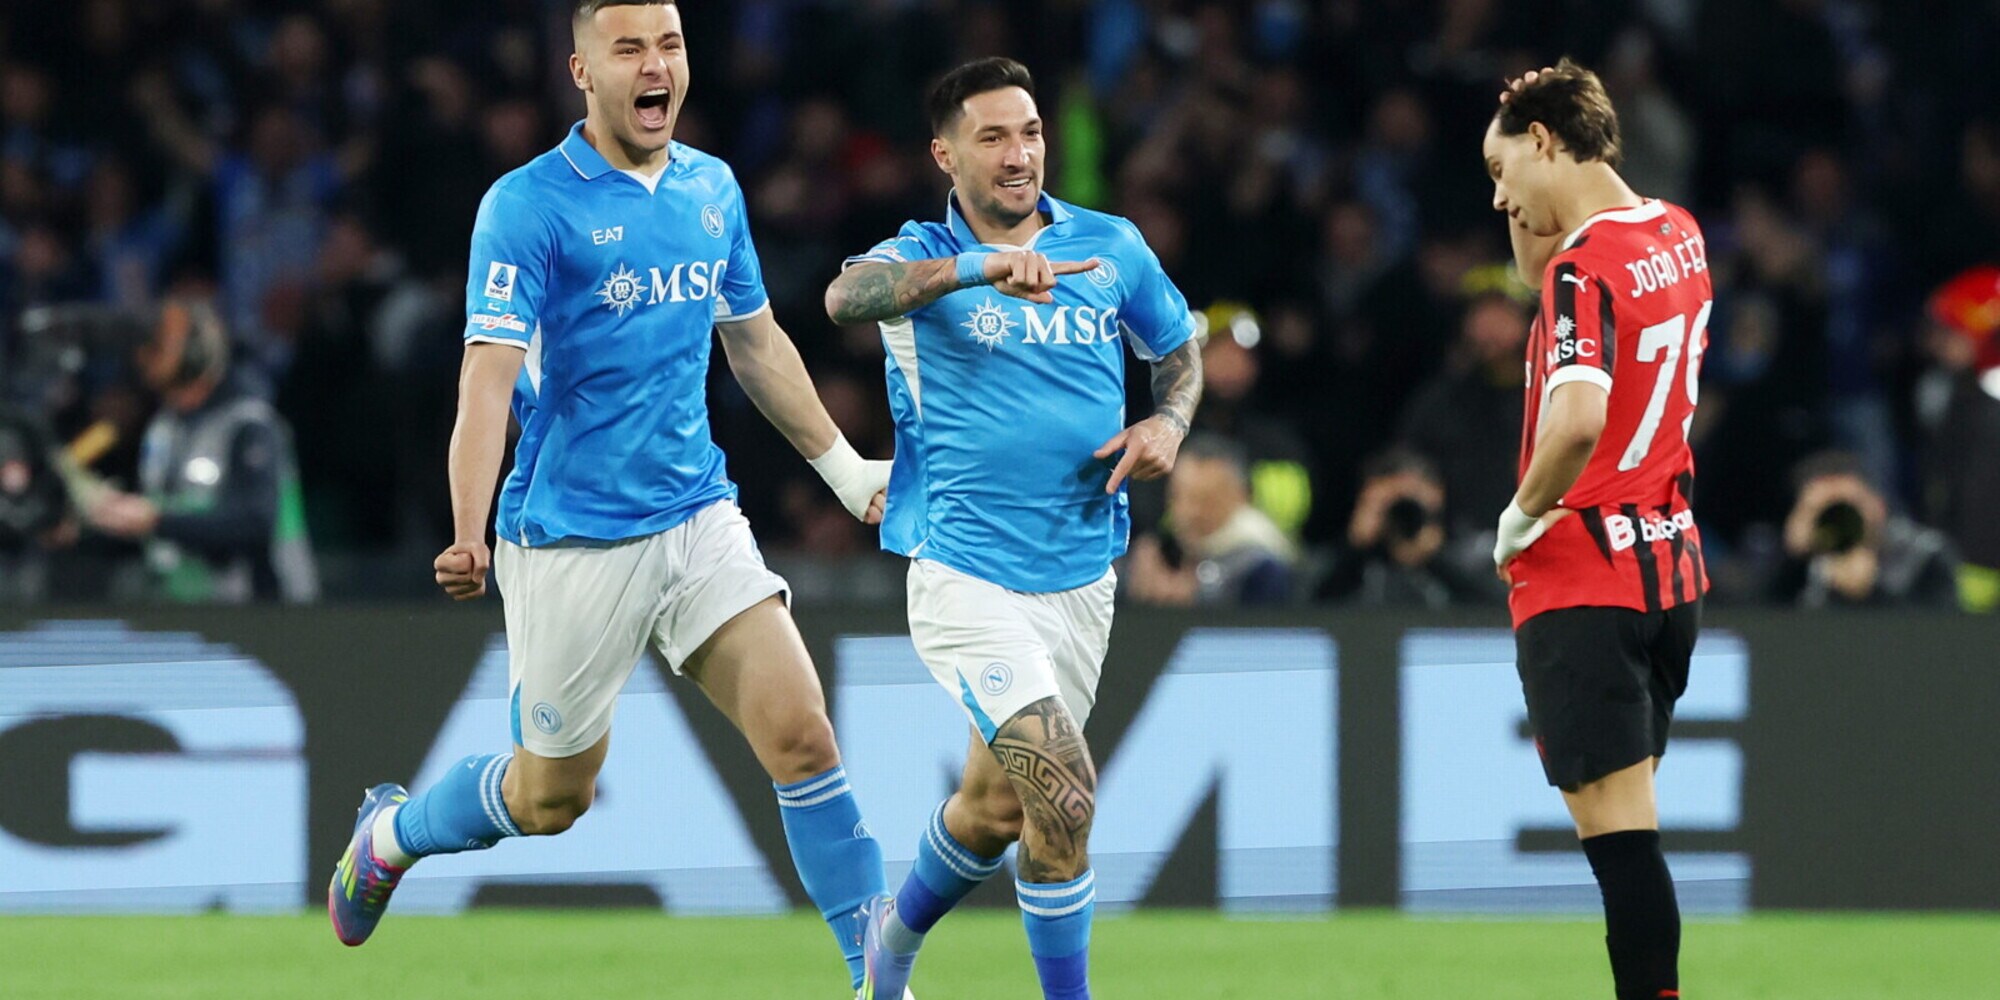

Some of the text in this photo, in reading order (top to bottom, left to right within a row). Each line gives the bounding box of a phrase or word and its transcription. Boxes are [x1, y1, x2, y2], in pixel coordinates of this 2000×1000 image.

[592, 226, 624, 246] EA7
[647, 258, 728, 306] MSC
[1625, 246, 1679, 298] JOÃO
[1020, 305, 1120, 345] MSC
[1546, 338, 1596, 371] MSC
[0, 619, 1751, 918] GAME
